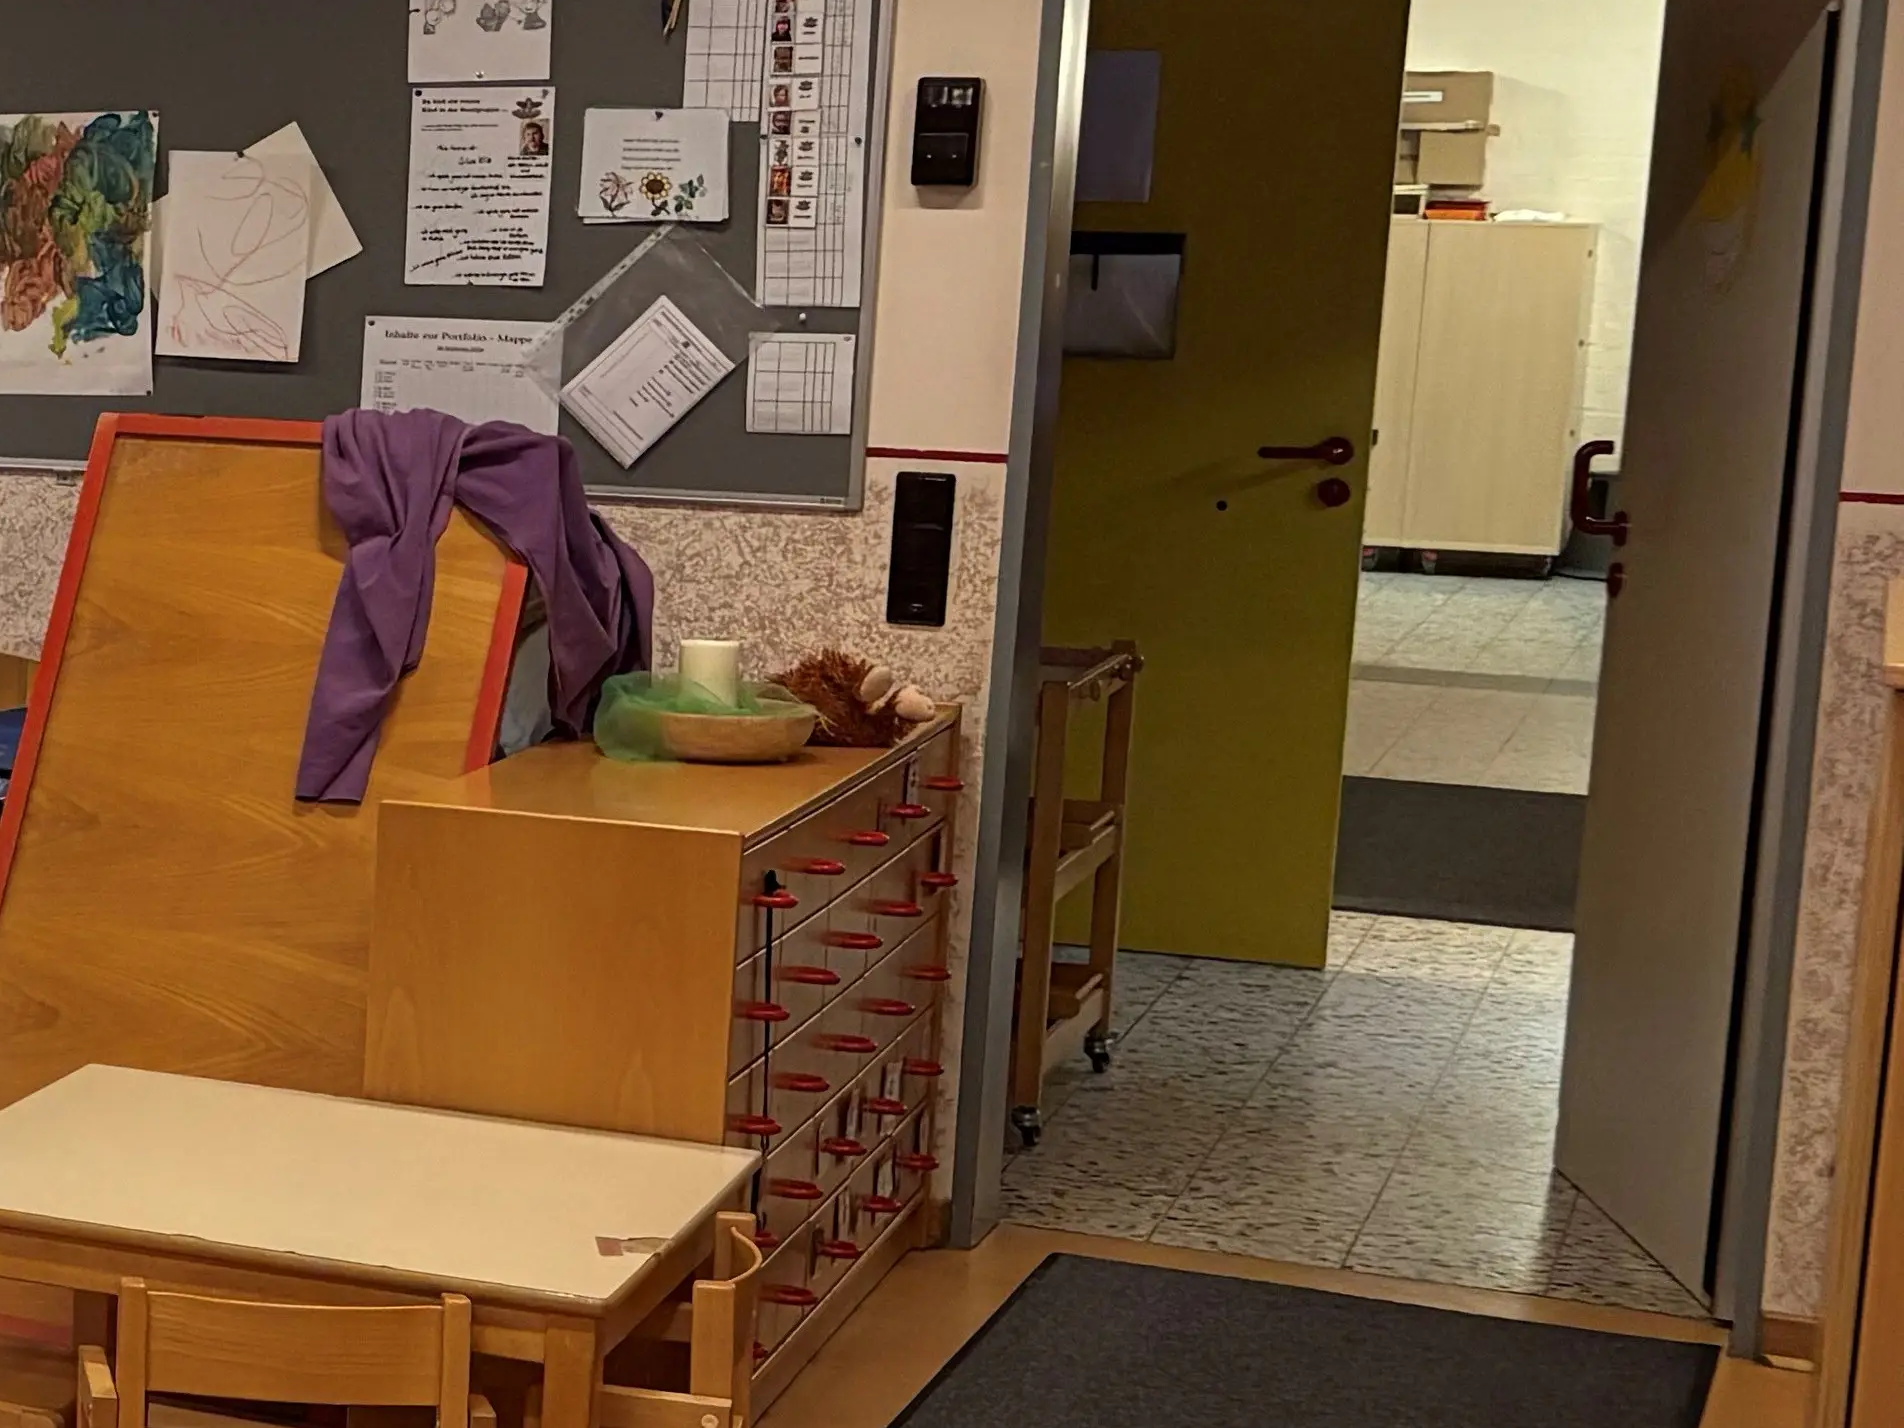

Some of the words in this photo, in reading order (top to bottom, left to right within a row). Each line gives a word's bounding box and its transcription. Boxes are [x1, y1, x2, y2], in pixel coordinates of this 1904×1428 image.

[385, 329, 419, 340] Inhalte
[441, 331, 488, 342] Portfolio
[497, 335, 533, 345] Mappe
